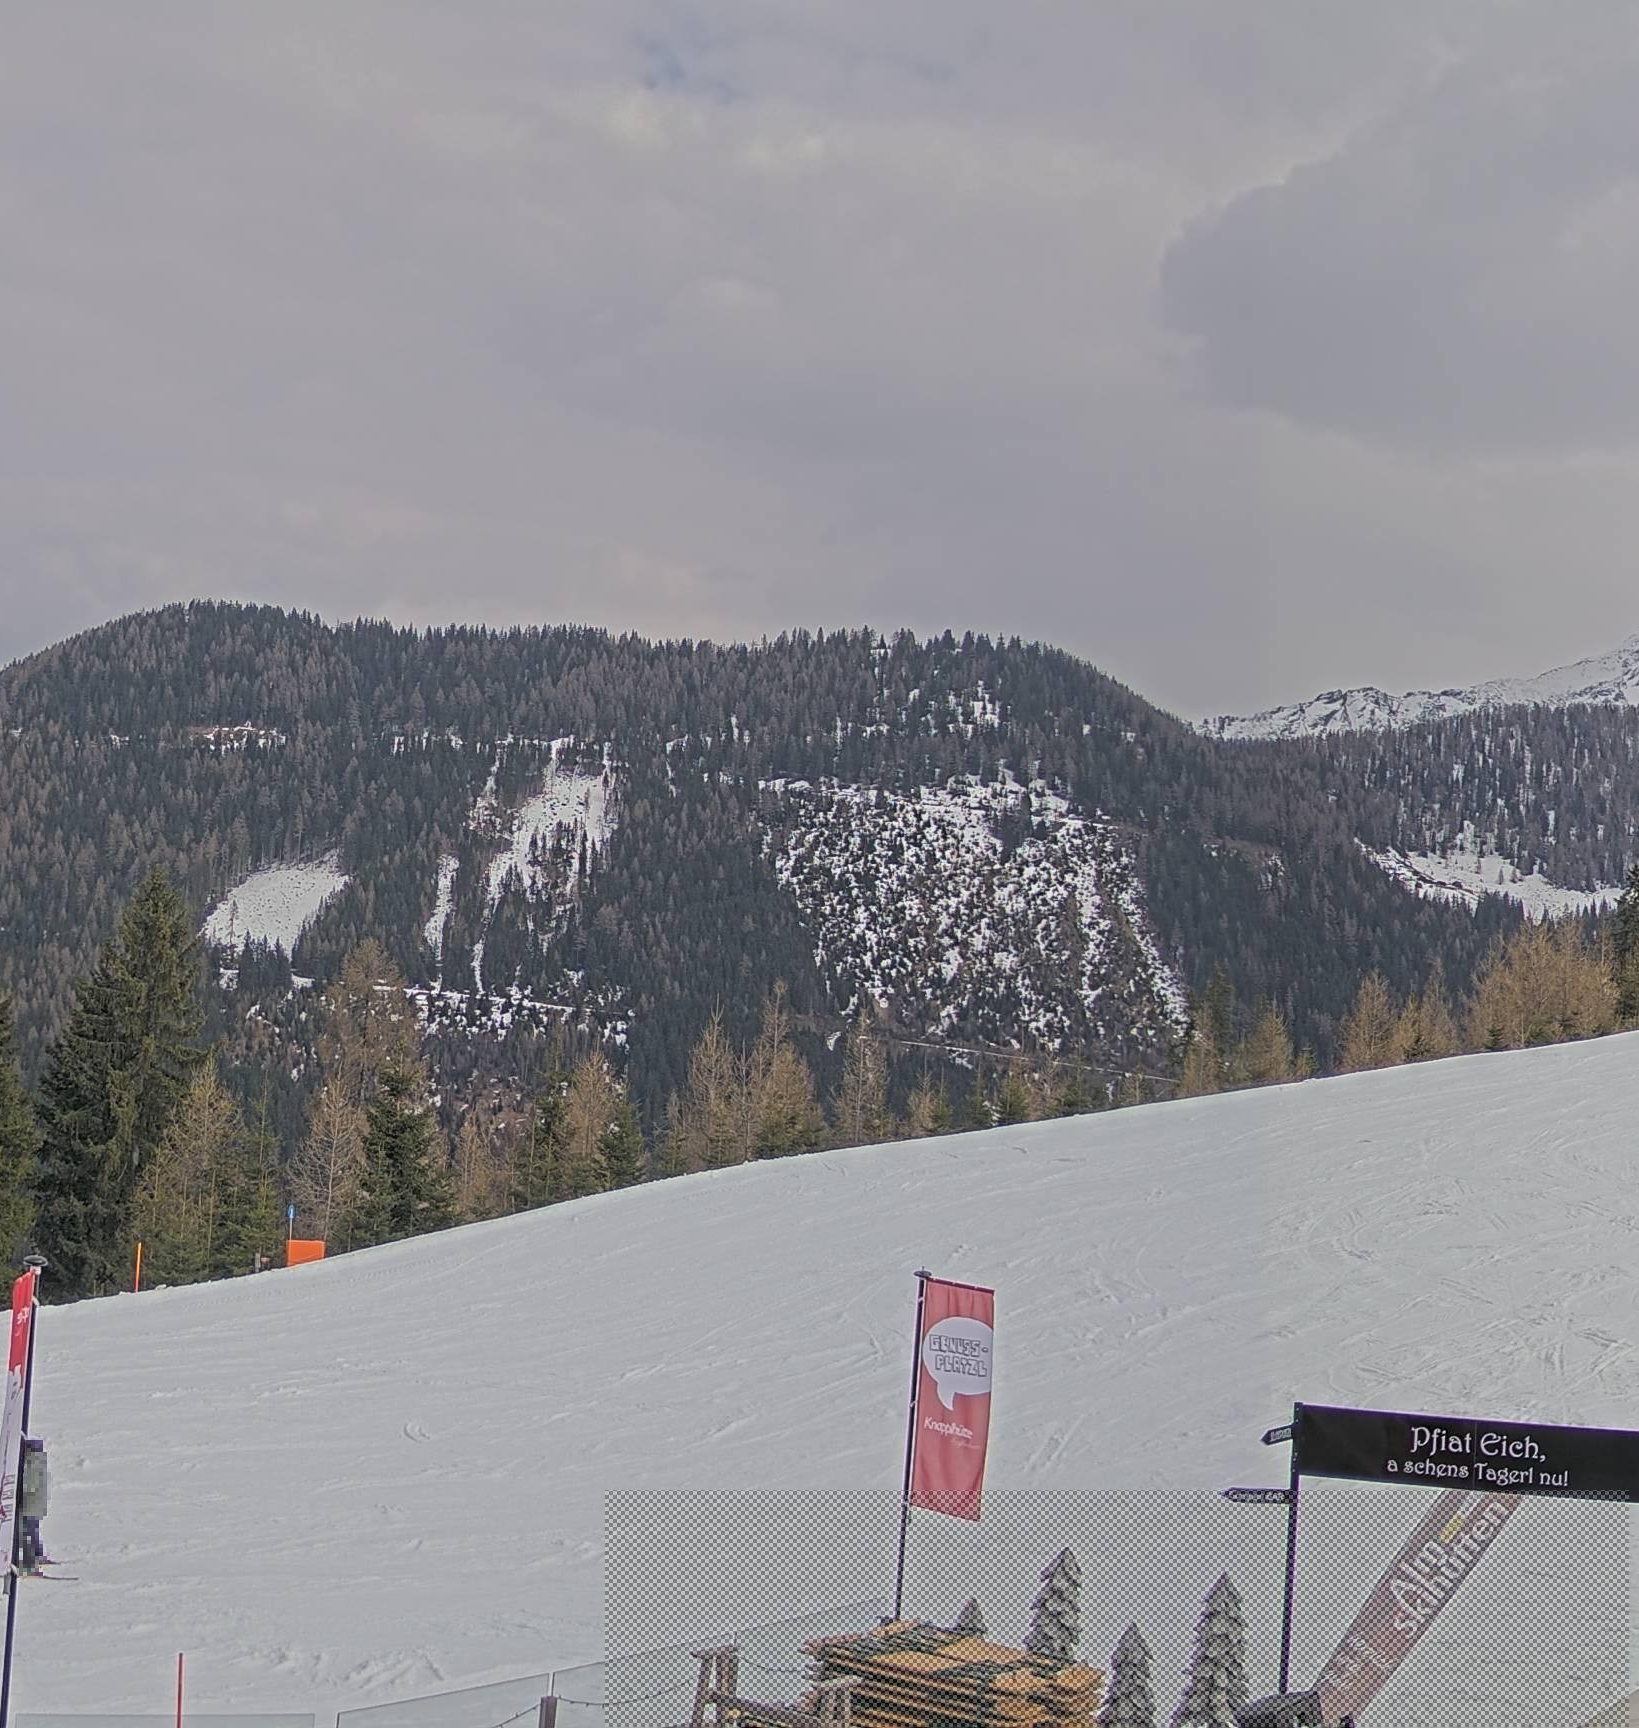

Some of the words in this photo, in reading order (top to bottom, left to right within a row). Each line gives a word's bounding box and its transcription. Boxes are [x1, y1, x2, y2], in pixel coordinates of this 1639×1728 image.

[935, 1354, 988, 1377] PLATZL
[1410, 1426, 1471, 1456] Pfiat
[1480, 1432, 1547, 1462] Eich,
[1387, 1459, 1398, 1472] a
[1403, 1458, 1470, 1479] schens
[1475, 1462, 1534, 1486] Tagerl
[1540, 1470, 1569, 1487] nu!
